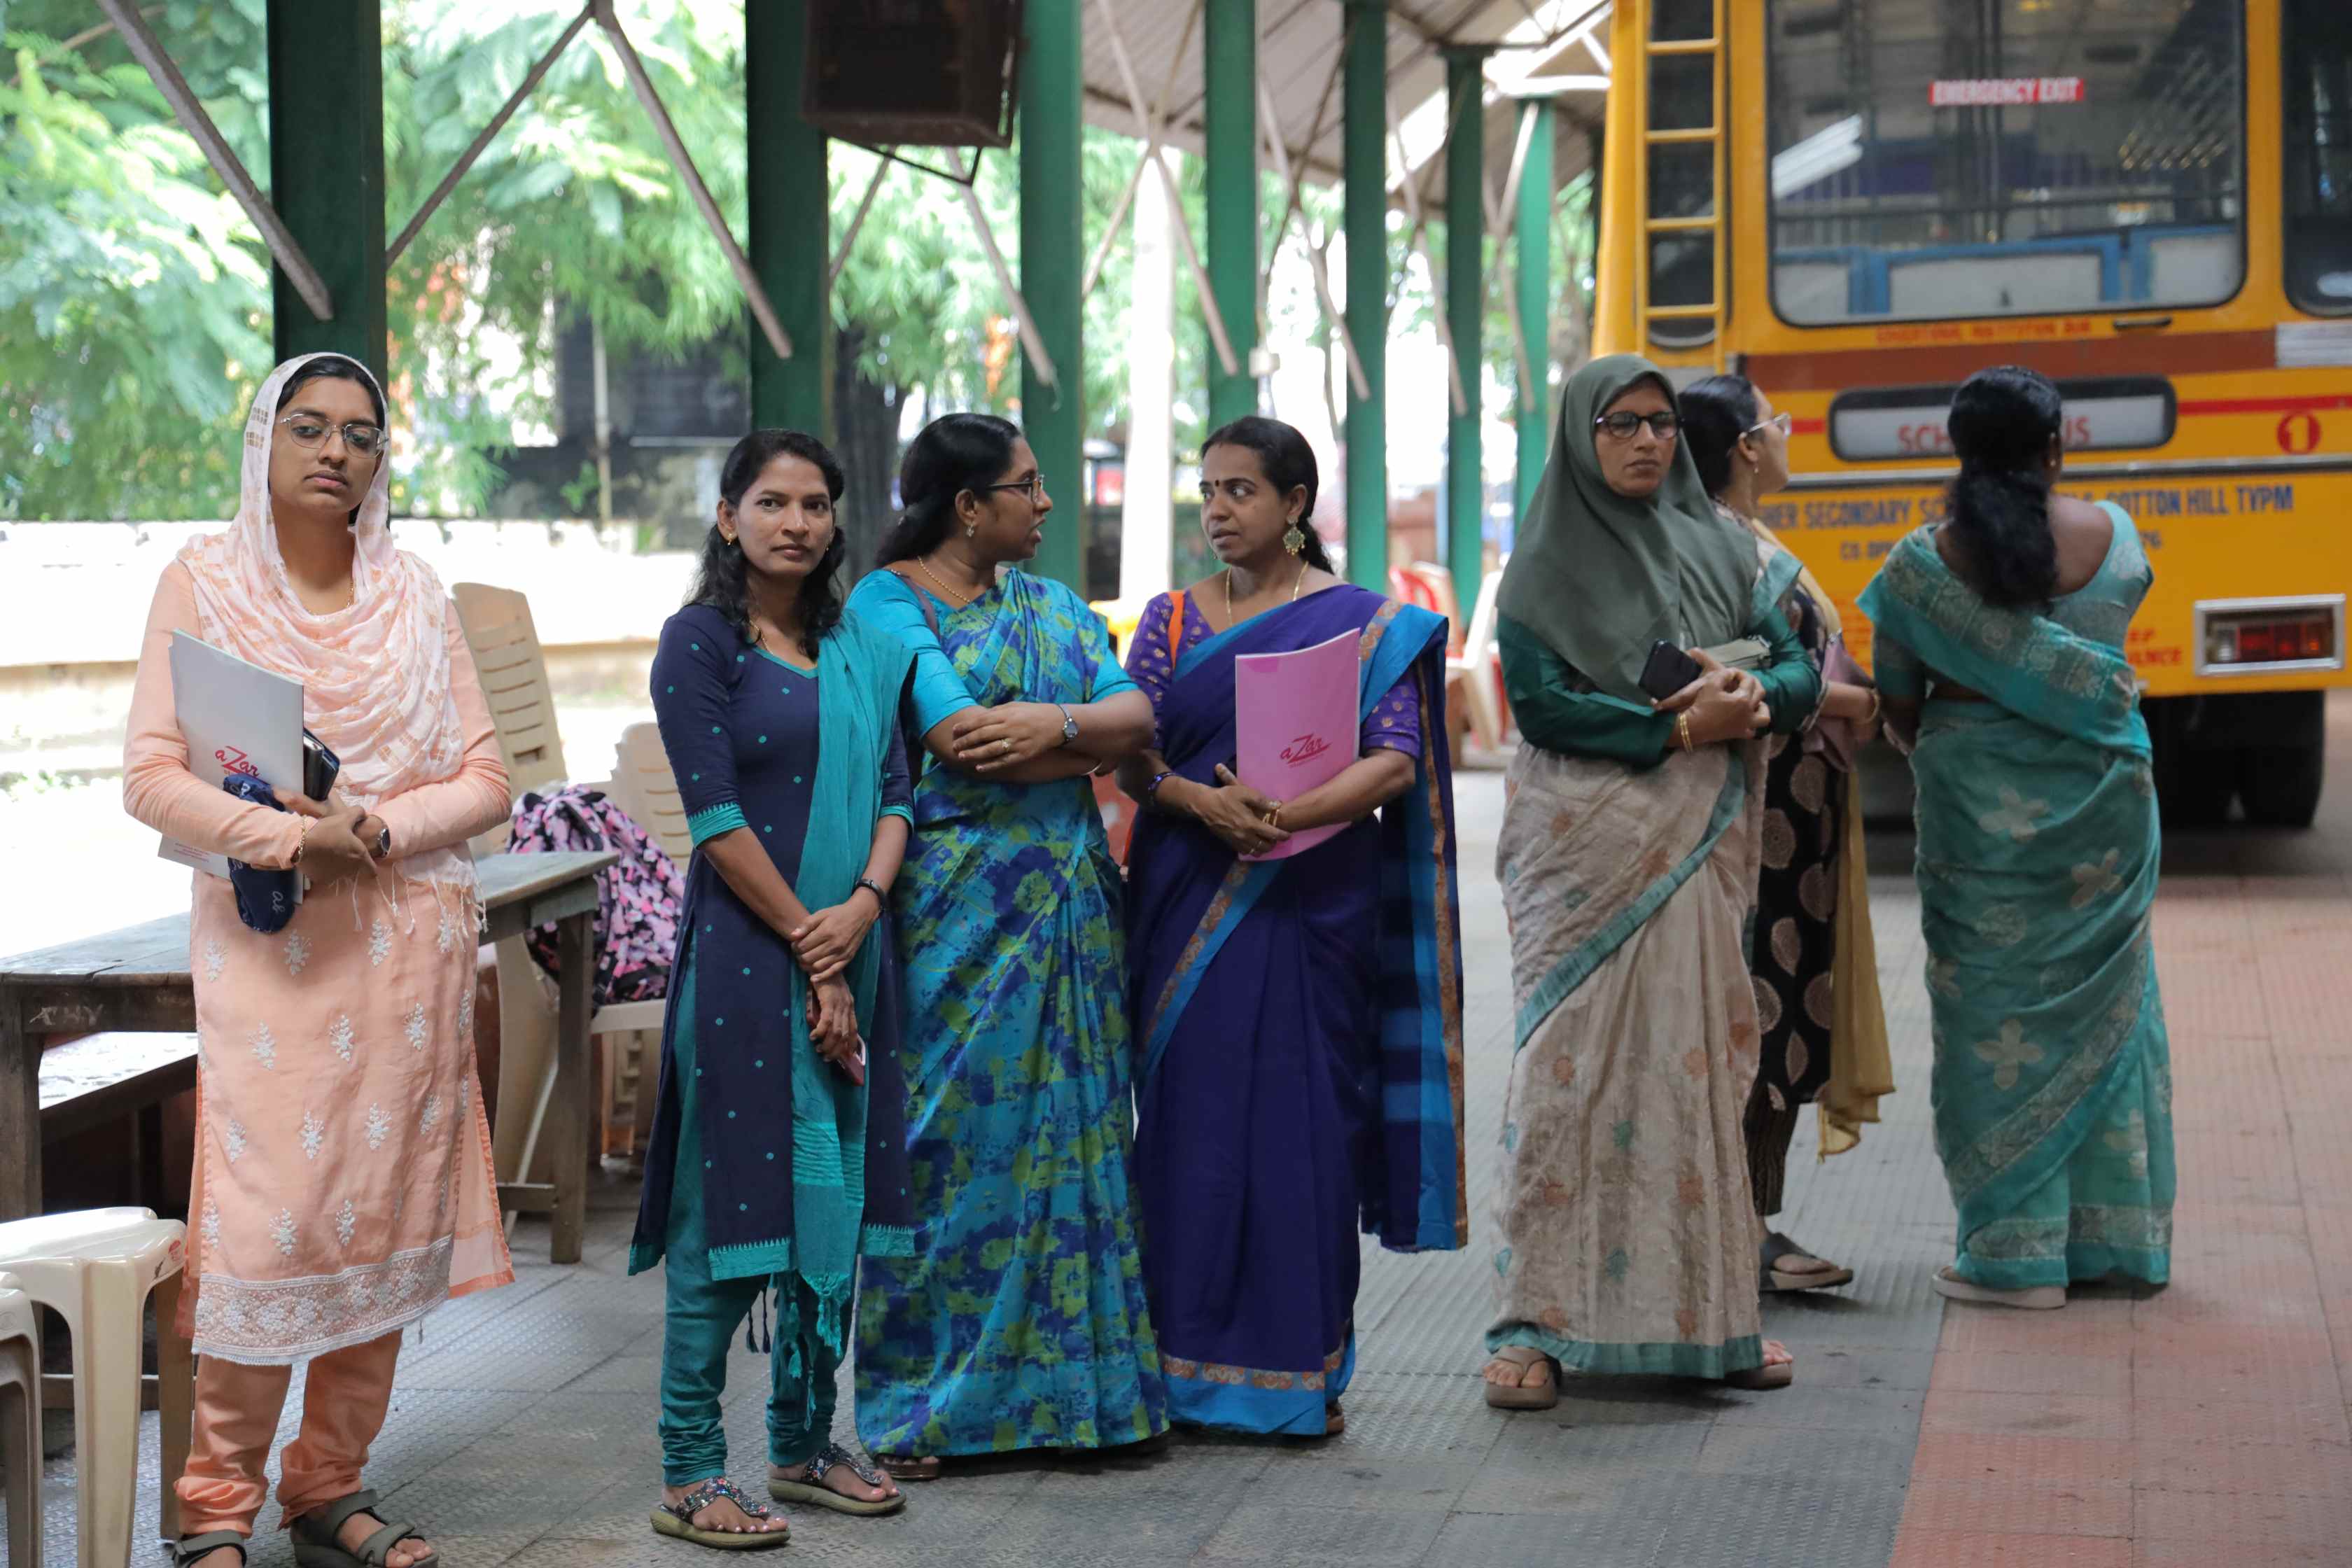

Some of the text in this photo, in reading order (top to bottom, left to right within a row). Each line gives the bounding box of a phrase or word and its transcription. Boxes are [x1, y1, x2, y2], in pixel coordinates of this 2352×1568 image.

[1933, 77, 2079, 105] EMERGENCY EXIT
[1897, 416, 2091, 452] SCH US
[1805, 498, 1911, 530] SECONDARY
[2187, 487, 2230, 515] HILL
